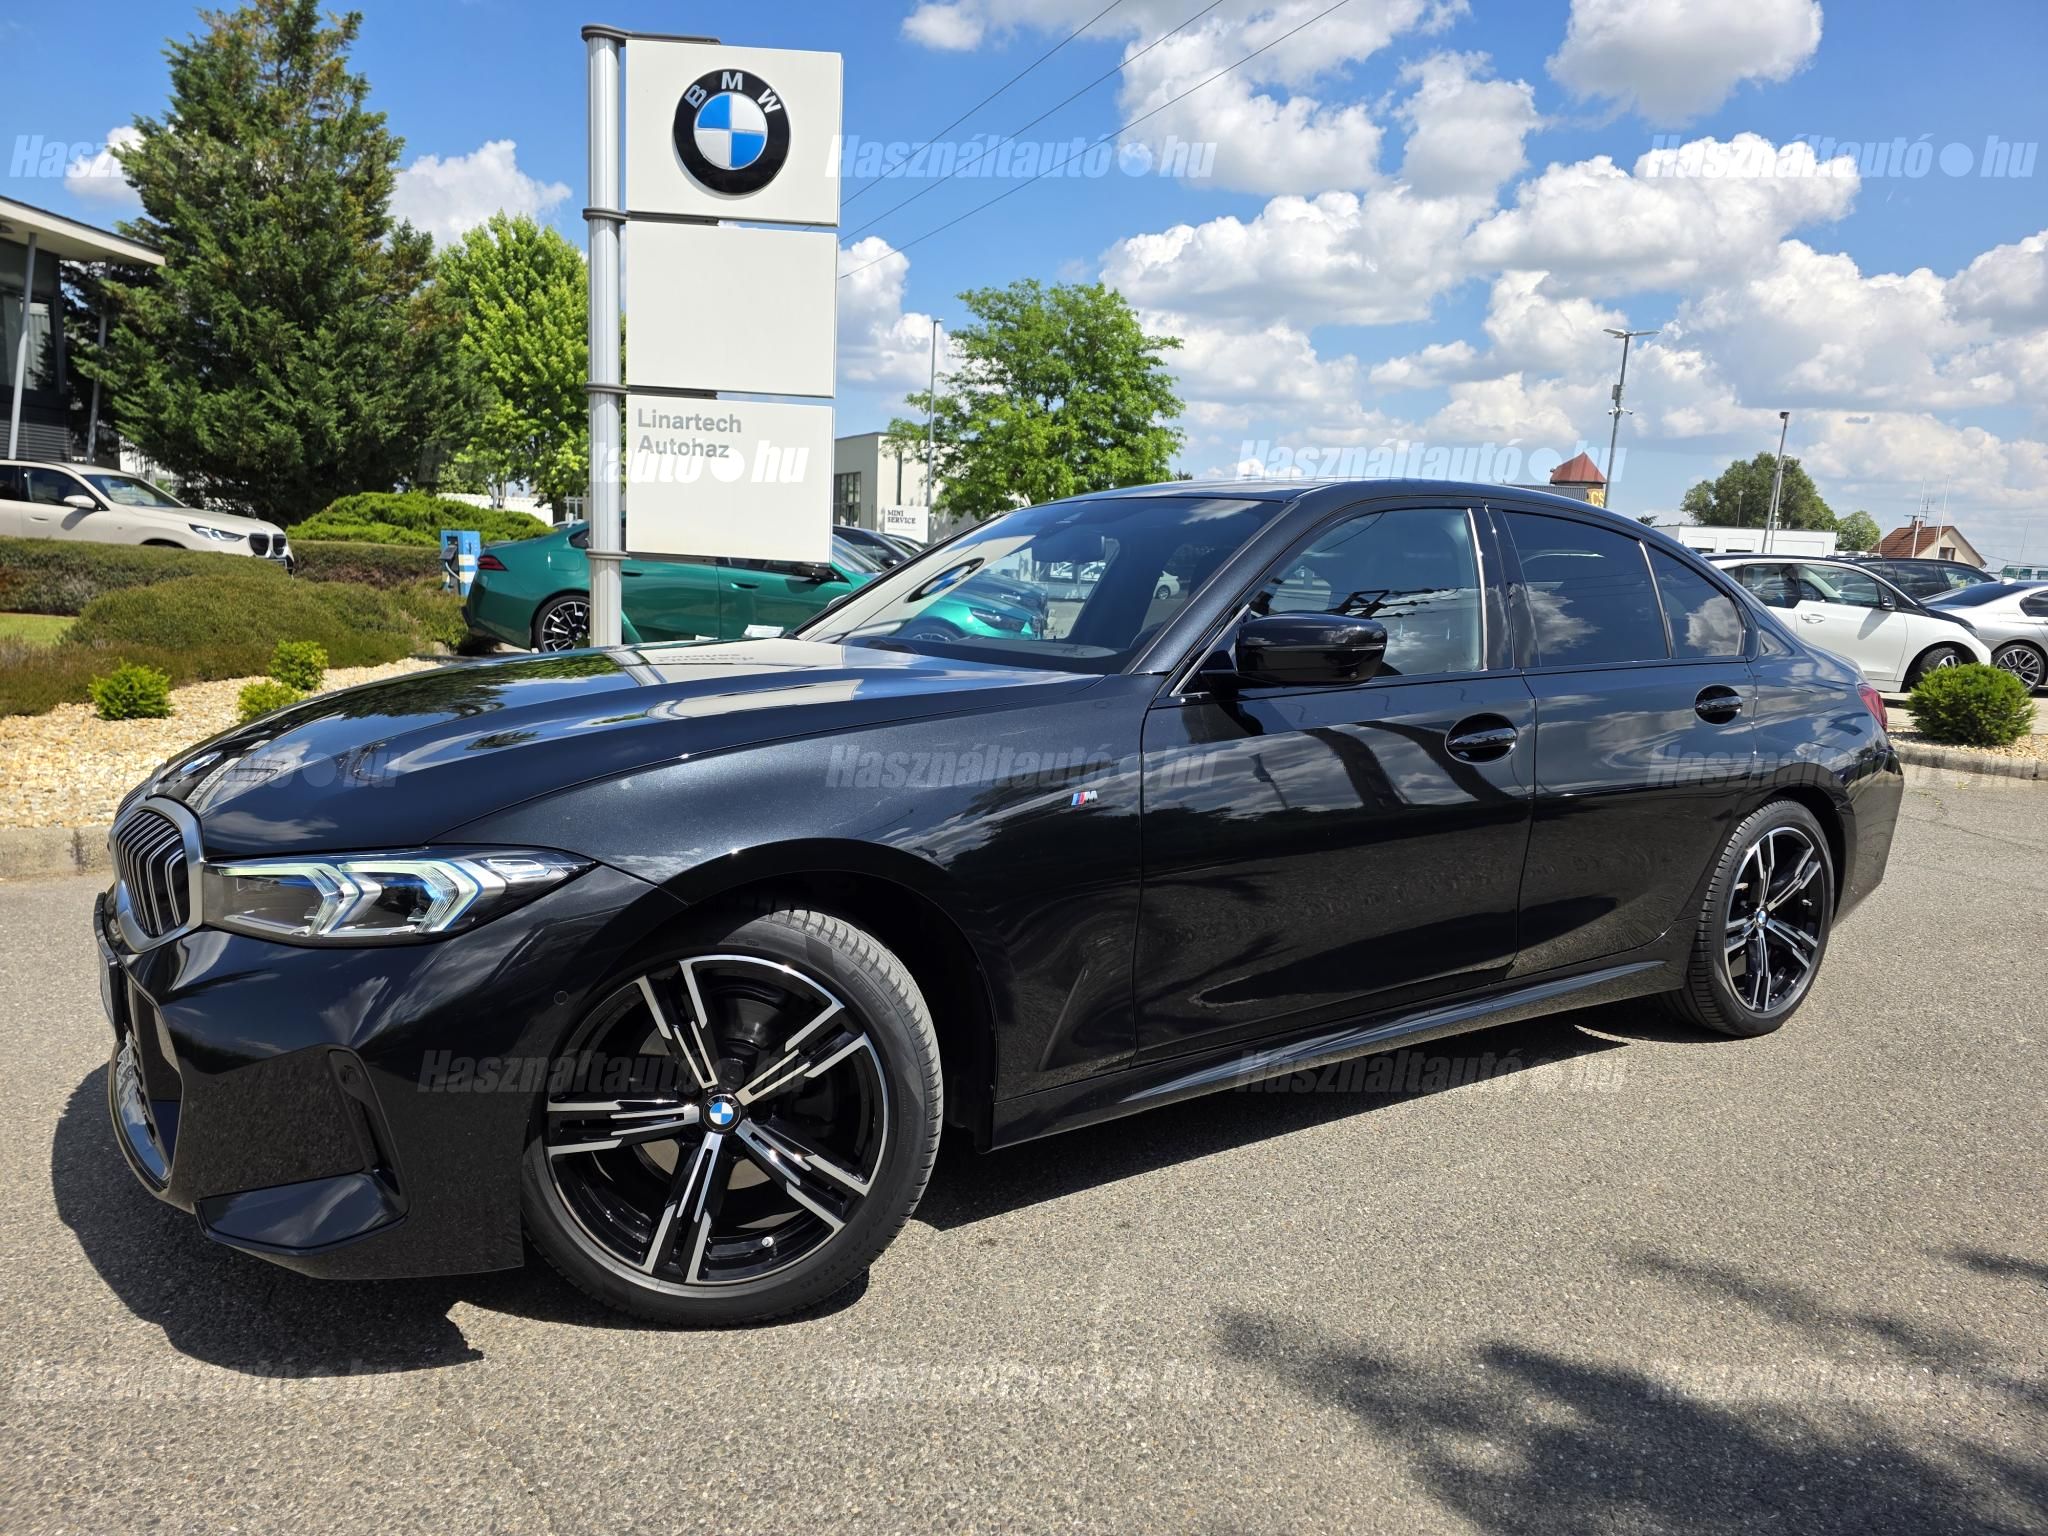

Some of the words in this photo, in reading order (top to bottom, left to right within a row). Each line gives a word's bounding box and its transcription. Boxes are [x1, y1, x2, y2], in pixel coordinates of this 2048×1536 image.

[684, 71, 782, 114] BMW
[637, 408, 743, 433] Linartech
[637, 435, 730, 458] Autohaz
[887, 516, 917, 525] SERVICE
